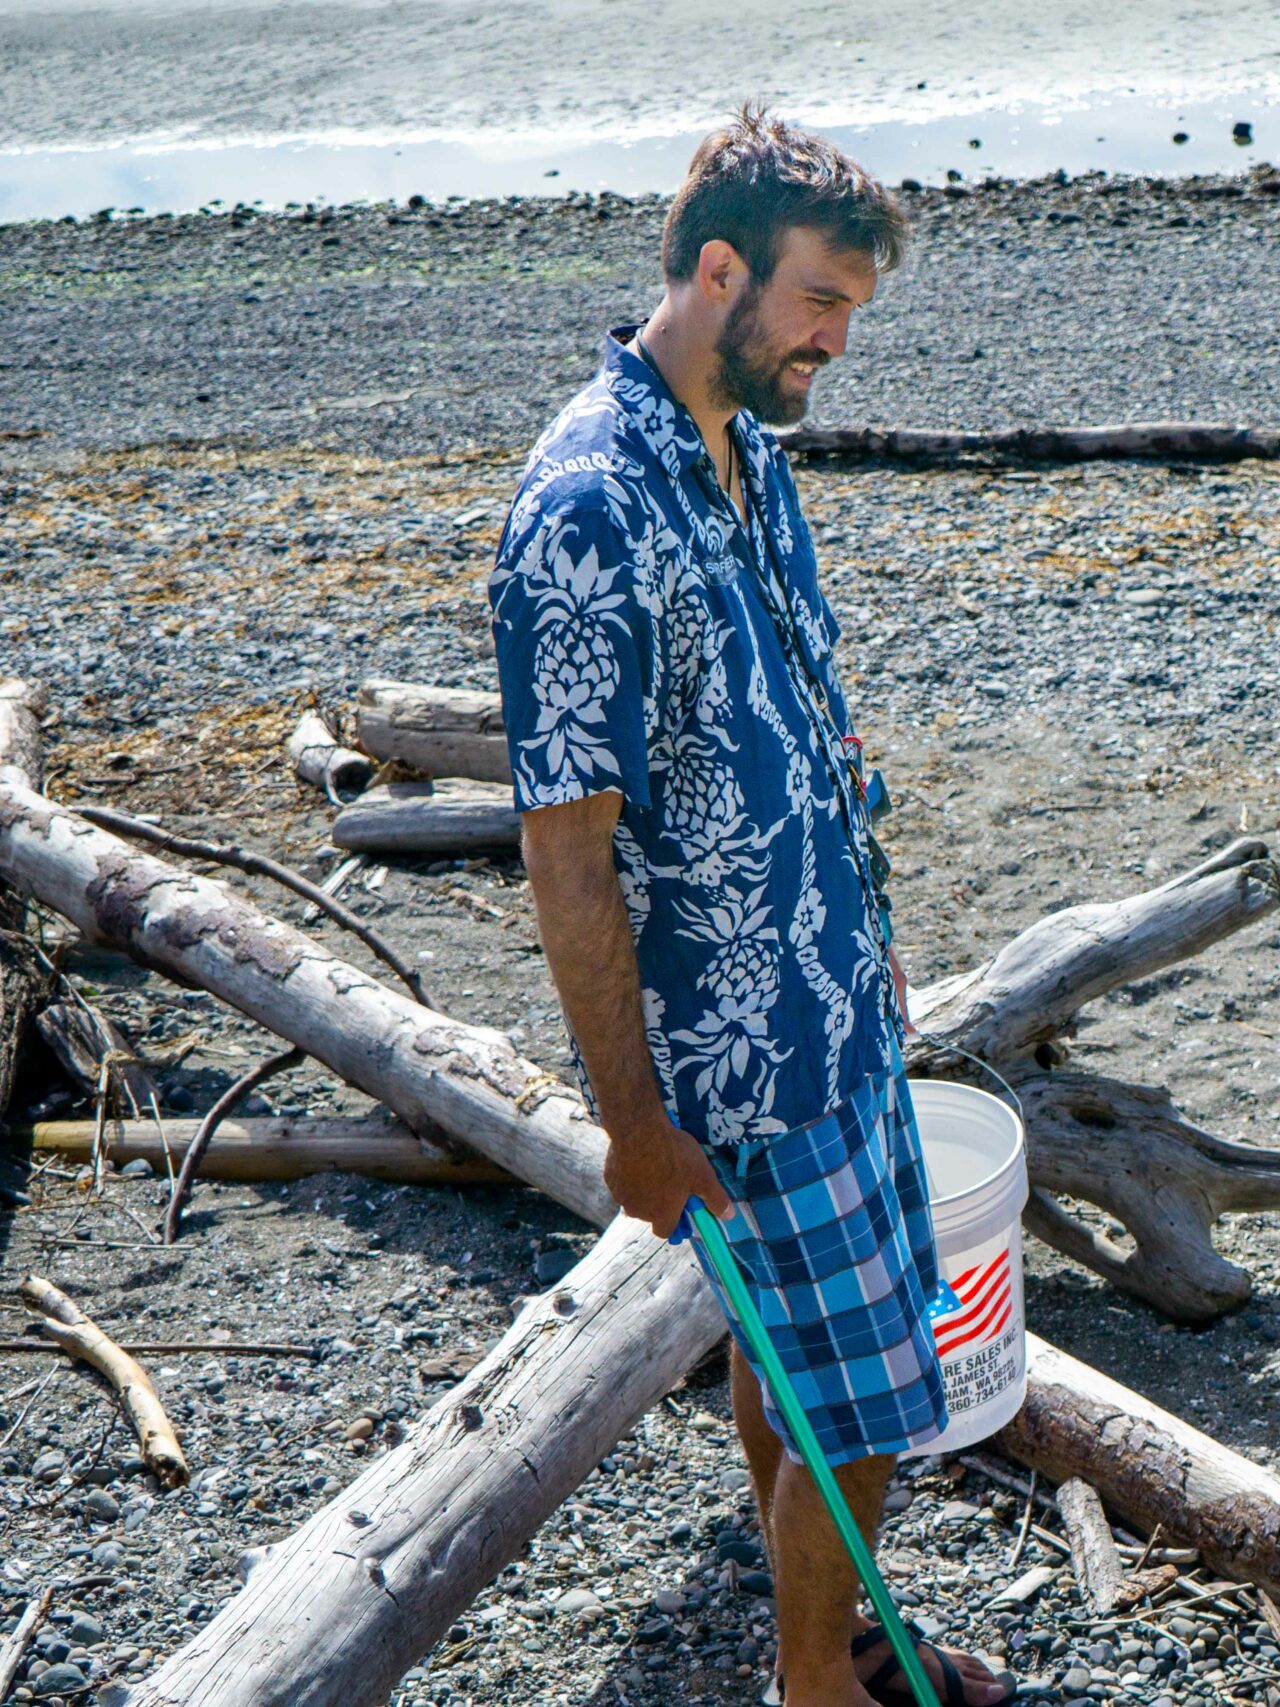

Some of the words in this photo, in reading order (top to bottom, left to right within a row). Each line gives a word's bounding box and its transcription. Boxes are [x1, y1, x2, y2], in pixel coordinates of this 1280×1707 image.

[944, 1362, 962, 1378] RE
[966, 1343, 1001, 1371] SALES
[951, 1366, 985, 1388] JAMES
[976, 1376, 991, 1390] WA
